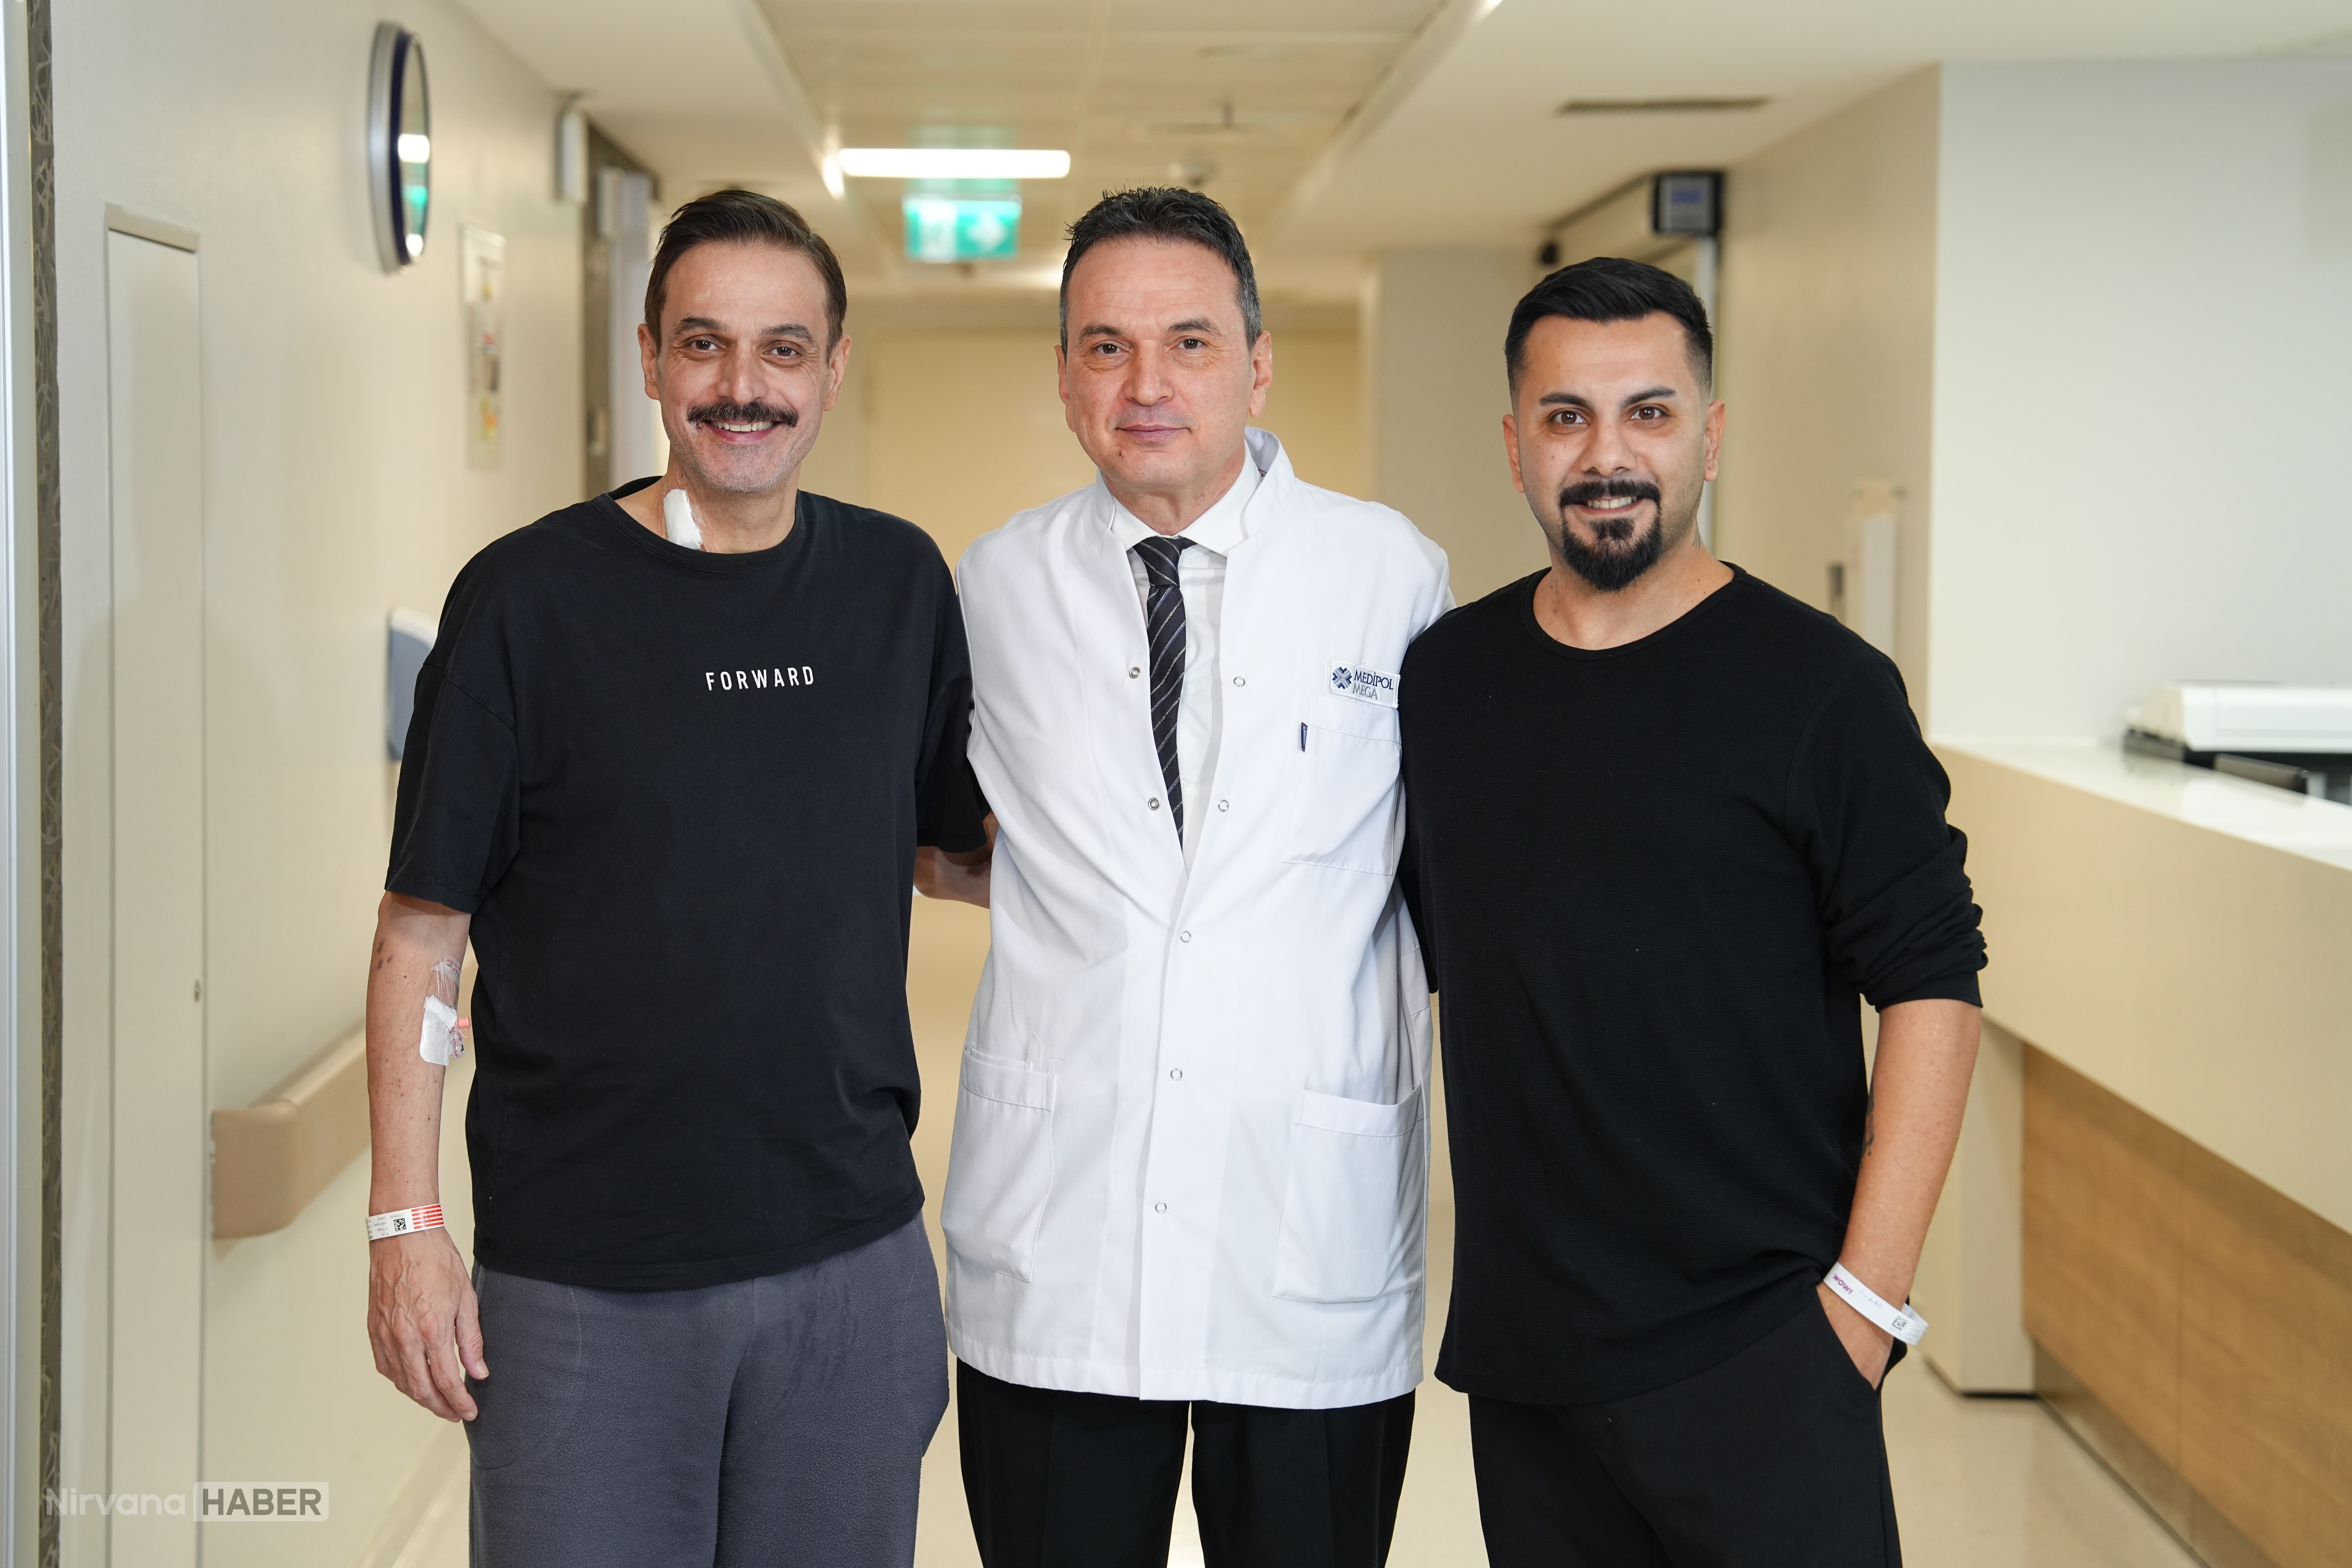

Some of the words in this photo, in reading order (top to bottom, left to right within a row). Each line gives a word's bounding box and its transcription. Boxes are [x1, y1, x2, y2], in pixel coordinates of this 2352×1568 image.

[705, 666, 814, 691] FORWARD
[1353, 682, 1378, 700] MEGA
[1833, 1273, 1853, 1294] WOW!
